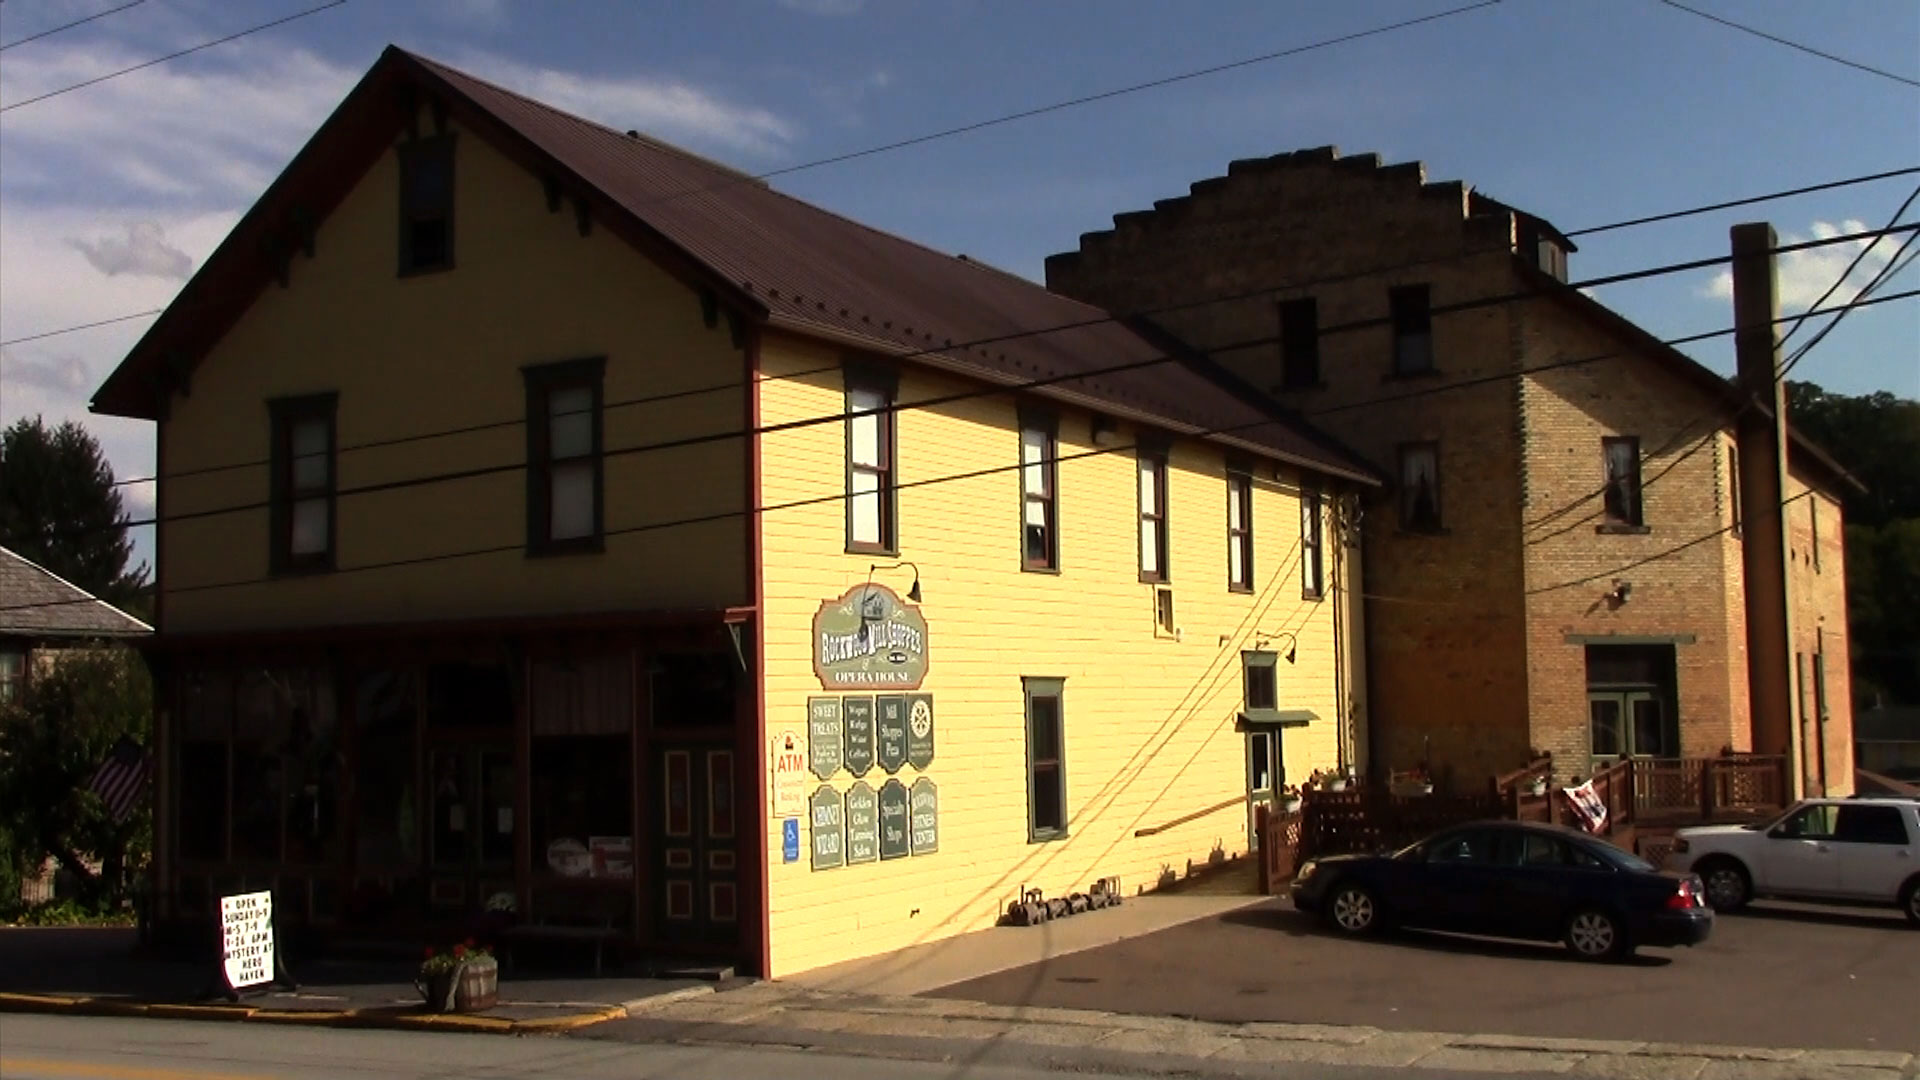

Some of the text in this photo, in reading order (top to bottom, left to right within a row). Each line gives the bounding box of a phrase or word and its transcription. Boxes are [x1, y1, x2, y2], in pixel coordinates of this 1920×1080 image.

[868, 622, 888, 655] MILL
[887, 620, 922, 655] SHOPPES
[835, 670, 911, 682] OPERA HOUSE
[813, 704, 836, 719] SWEET
[886, 704, 897, 719] Mill
[813, 721, 839, 736] TREATS
[777, 754, 804, 773] ATM
[850, 796, 873, 810] Golden
[850, 828, 875, 842] Tanning
[914, 829, 936, 846] CENTER
[853, 843, 871, 857] Salon
[235, 898, 257, 910] OPEN
[225, 910, 254, 924] SUNDAY
[224, 942, 273, 959] MYSTERY AT
[242, 957, 263, 970] HERO
[239, 969, 265, 982] HAVEN
